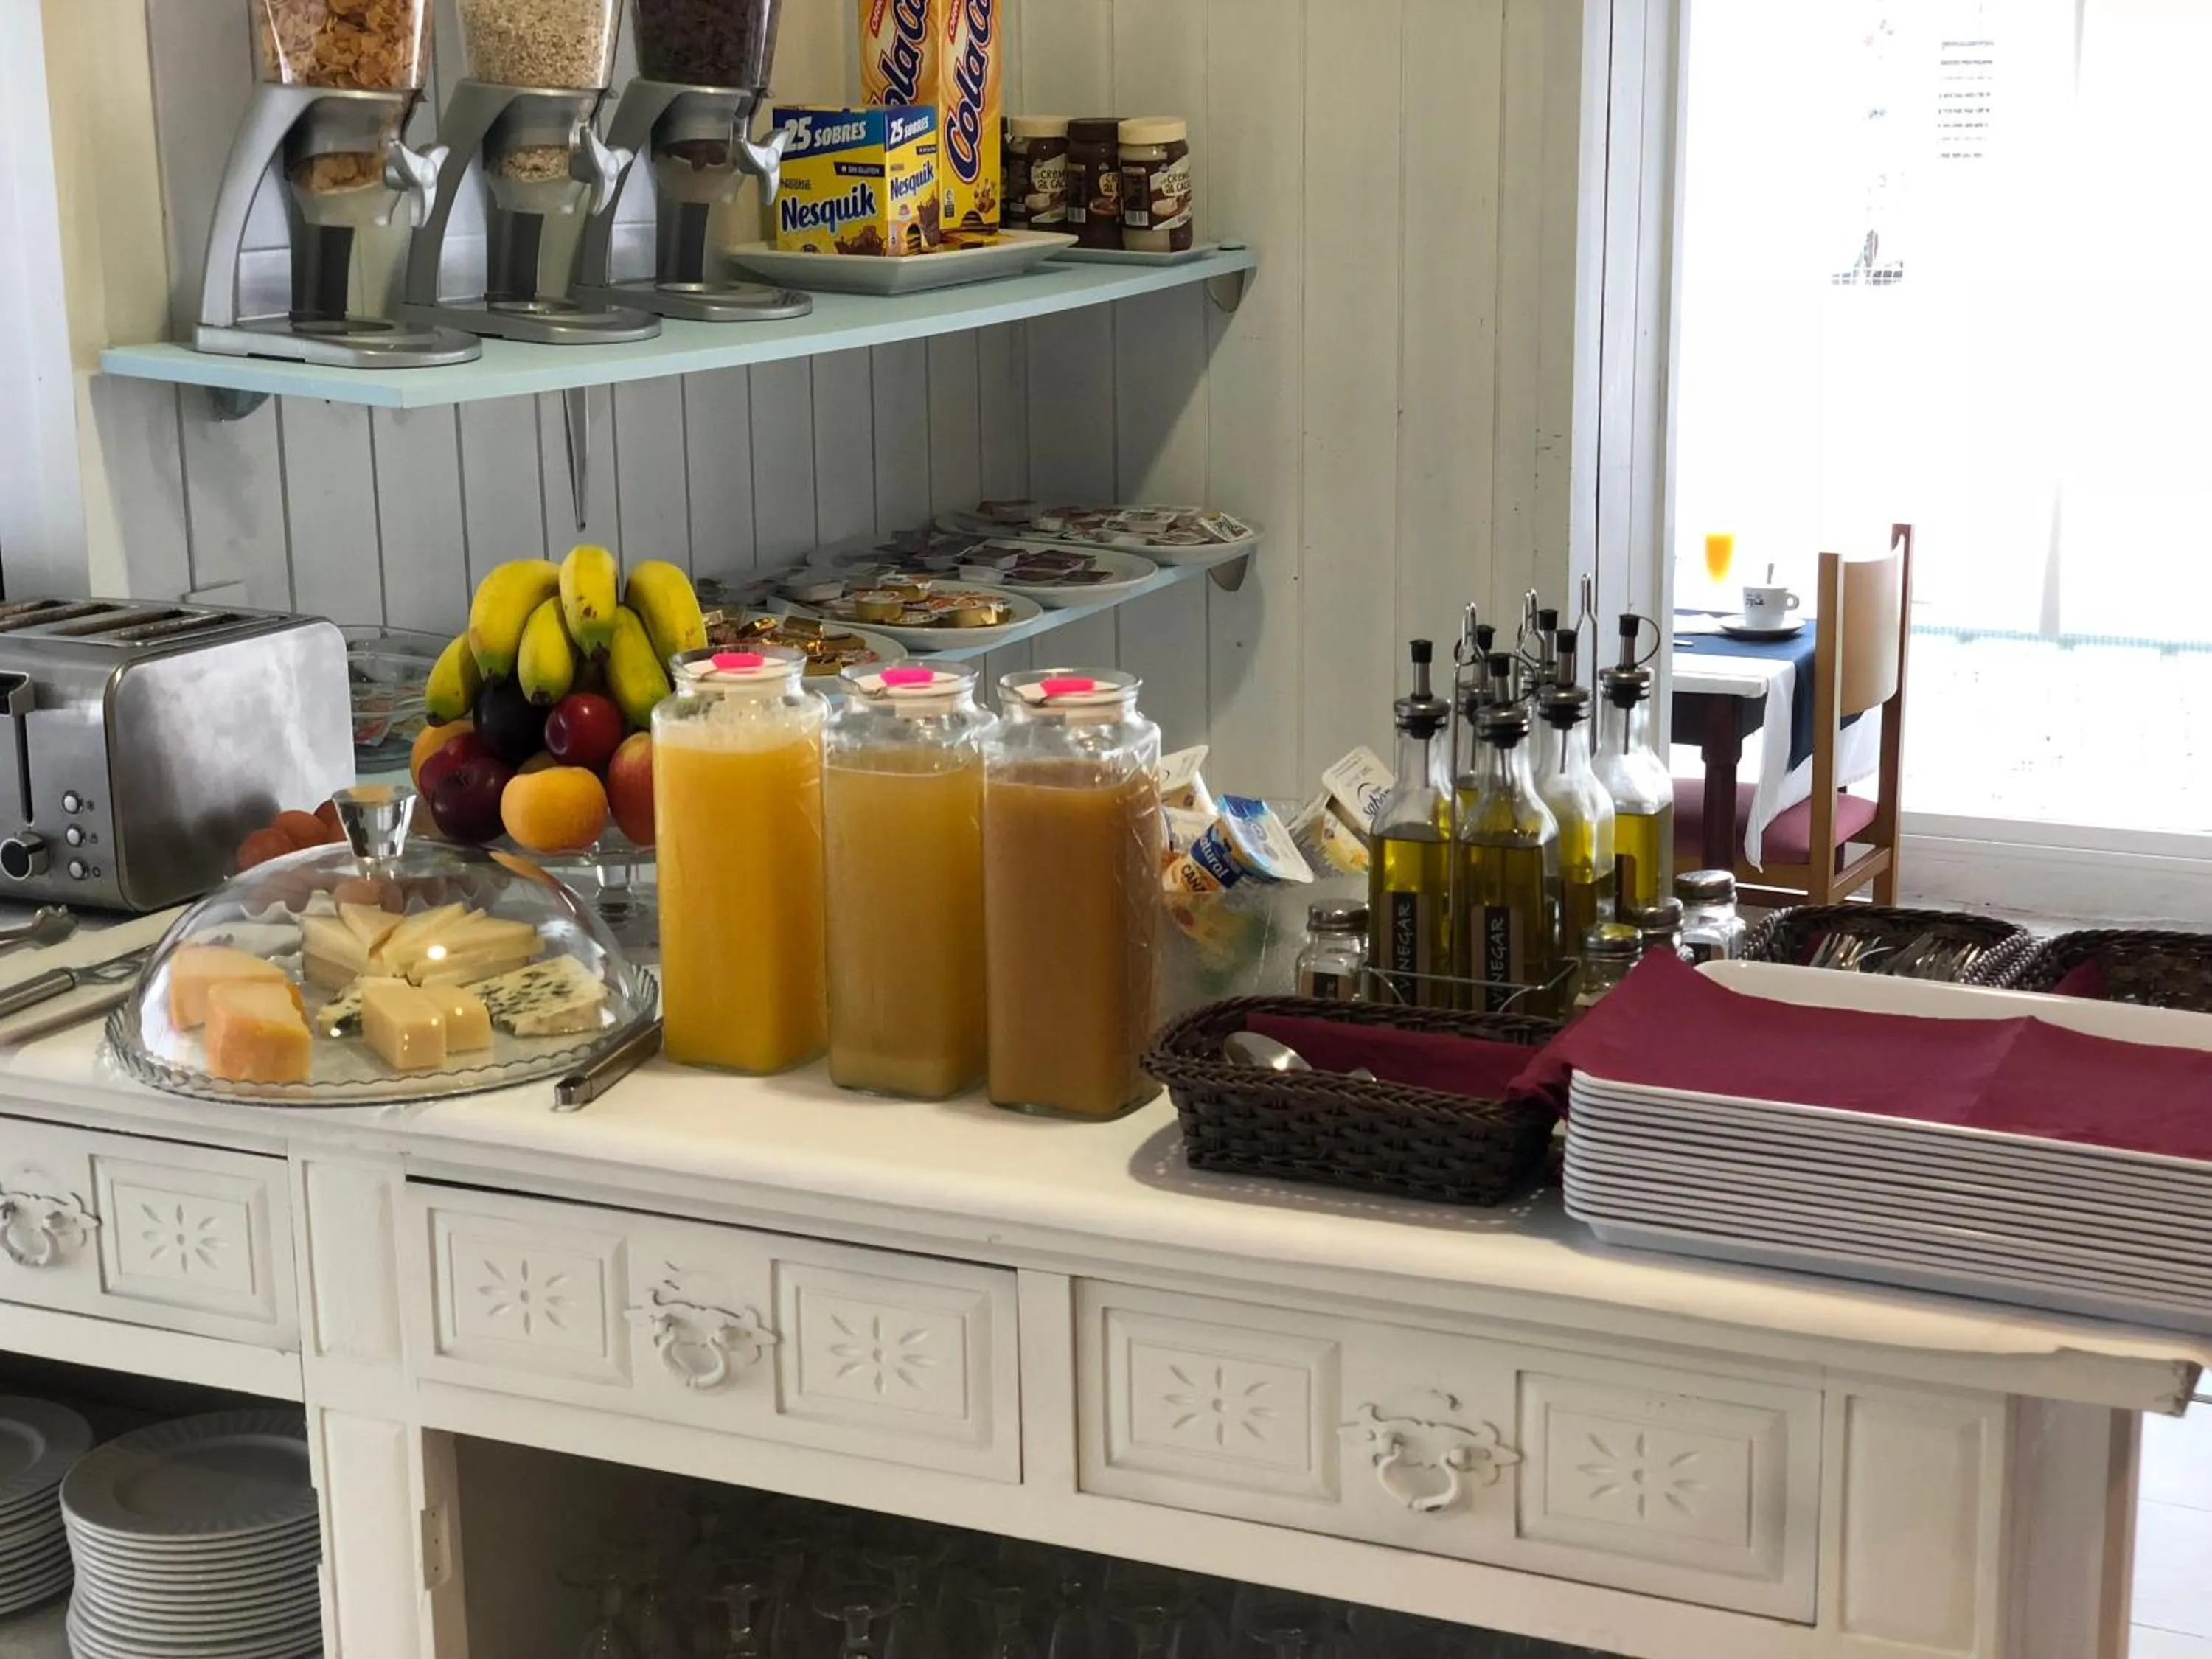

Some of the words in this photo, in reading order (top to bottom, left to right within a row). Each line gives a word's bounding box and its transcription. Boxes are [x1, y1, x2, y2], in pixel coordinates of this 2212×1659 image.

[782, 116, 812, 152] 25
[814, 121, 866, 147] SOBRES
[890, 117, 903, 145] 25
[890, 160, 934, 200] Nesquik
[781, 181, 877, 234] Nesquik
[1200, 837, 1230, 879] atural
[1397, 902, 1413, 990] VNEGAR
[1490, 917, 1508, 1004] VINEGAR
